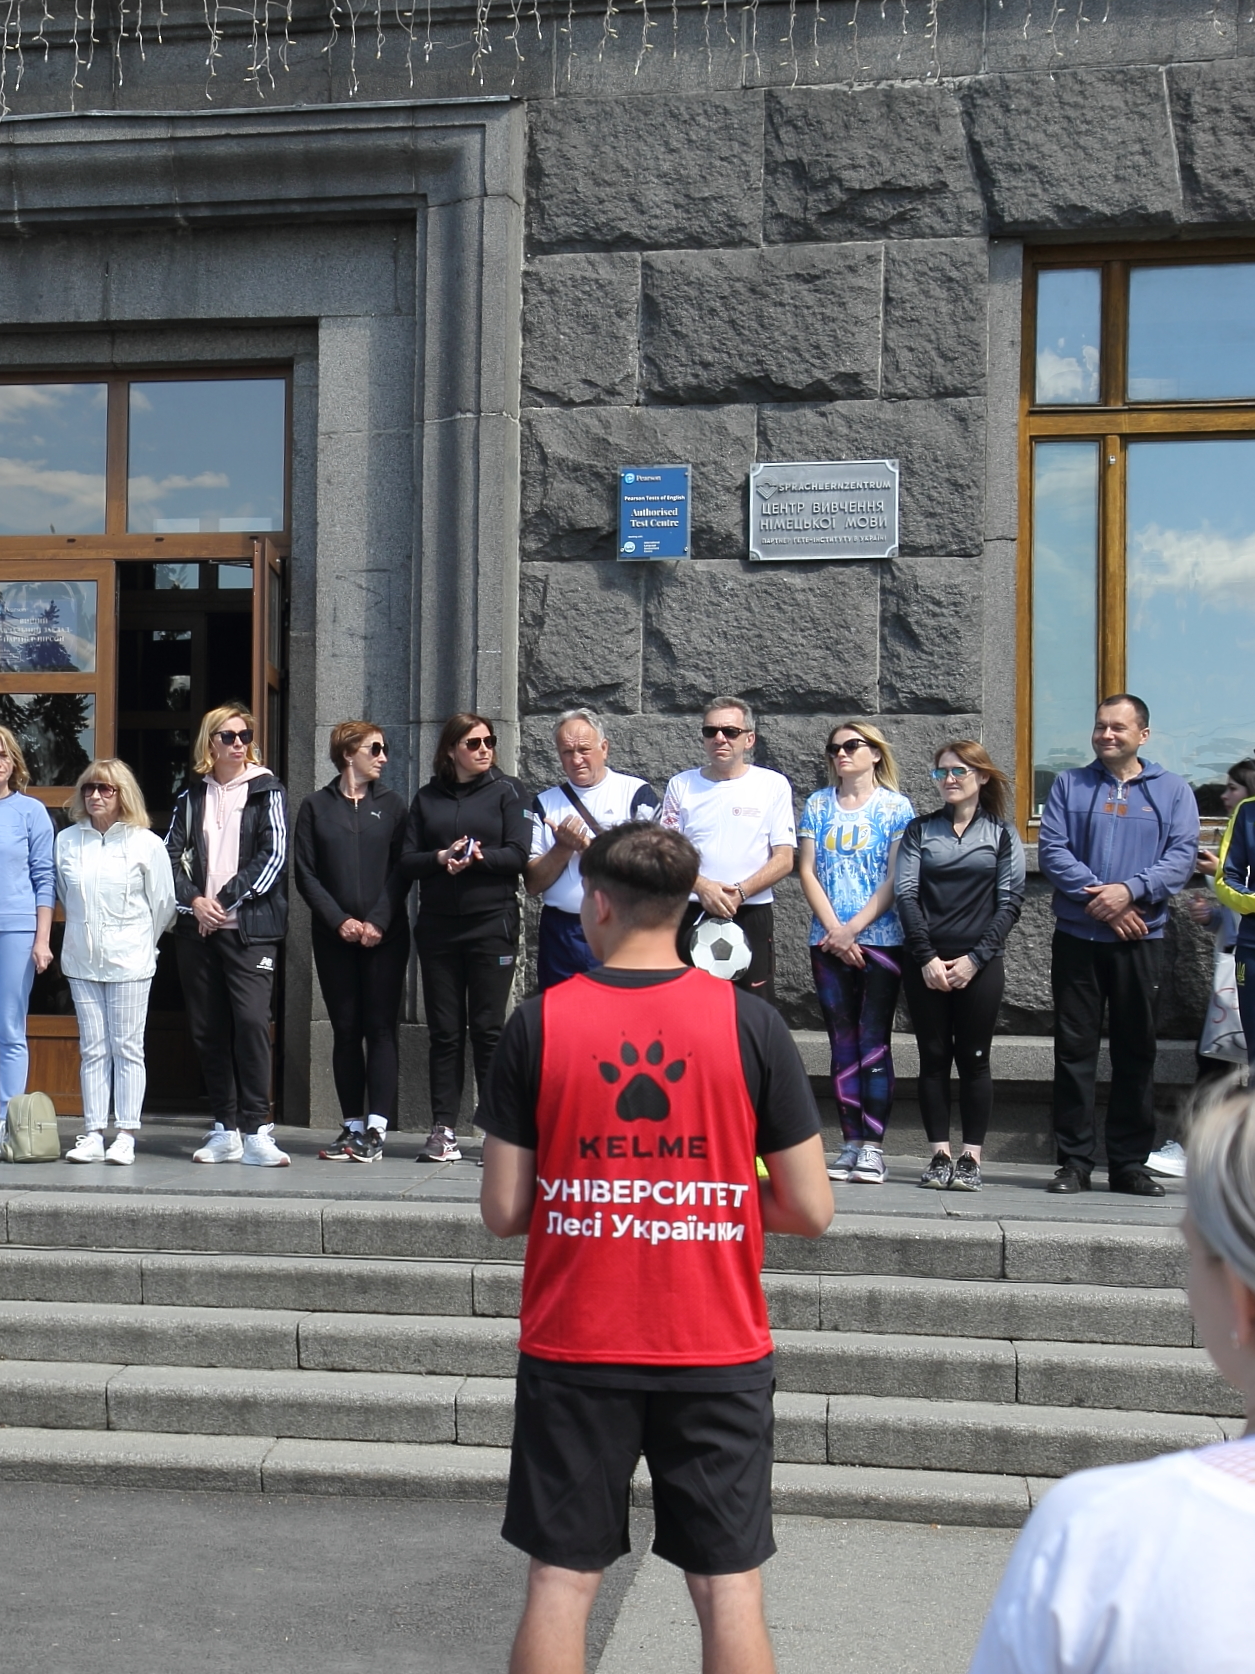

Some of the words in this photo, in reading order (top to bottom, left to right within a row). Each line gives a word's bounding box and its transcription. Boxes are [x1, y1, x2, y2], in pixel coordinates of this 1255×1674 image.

[778, 481, 891, 492] SPRACHLERNZENTRUM
[631, 507, 678, 517] Authorised
[762, 502, 805, 516] ЦЕНТР
[812, 501, 884, 514] ВИВЧЕННЯ
[630, 519, 648, 527] Test
[650, 519, 679, 528] Centre
[760, 516, 836, 531] НІМЕЦЬКОЇ
[845, 516, 887, 529] МОВИ
[579, 1135, 707, 1159] KELME
[540, 1178, 749, 1208] УНІВЕРСИТЕТ
[546, 1211, 602, 1238] Лесі
[611, 1213, 745, 1245] Українки
